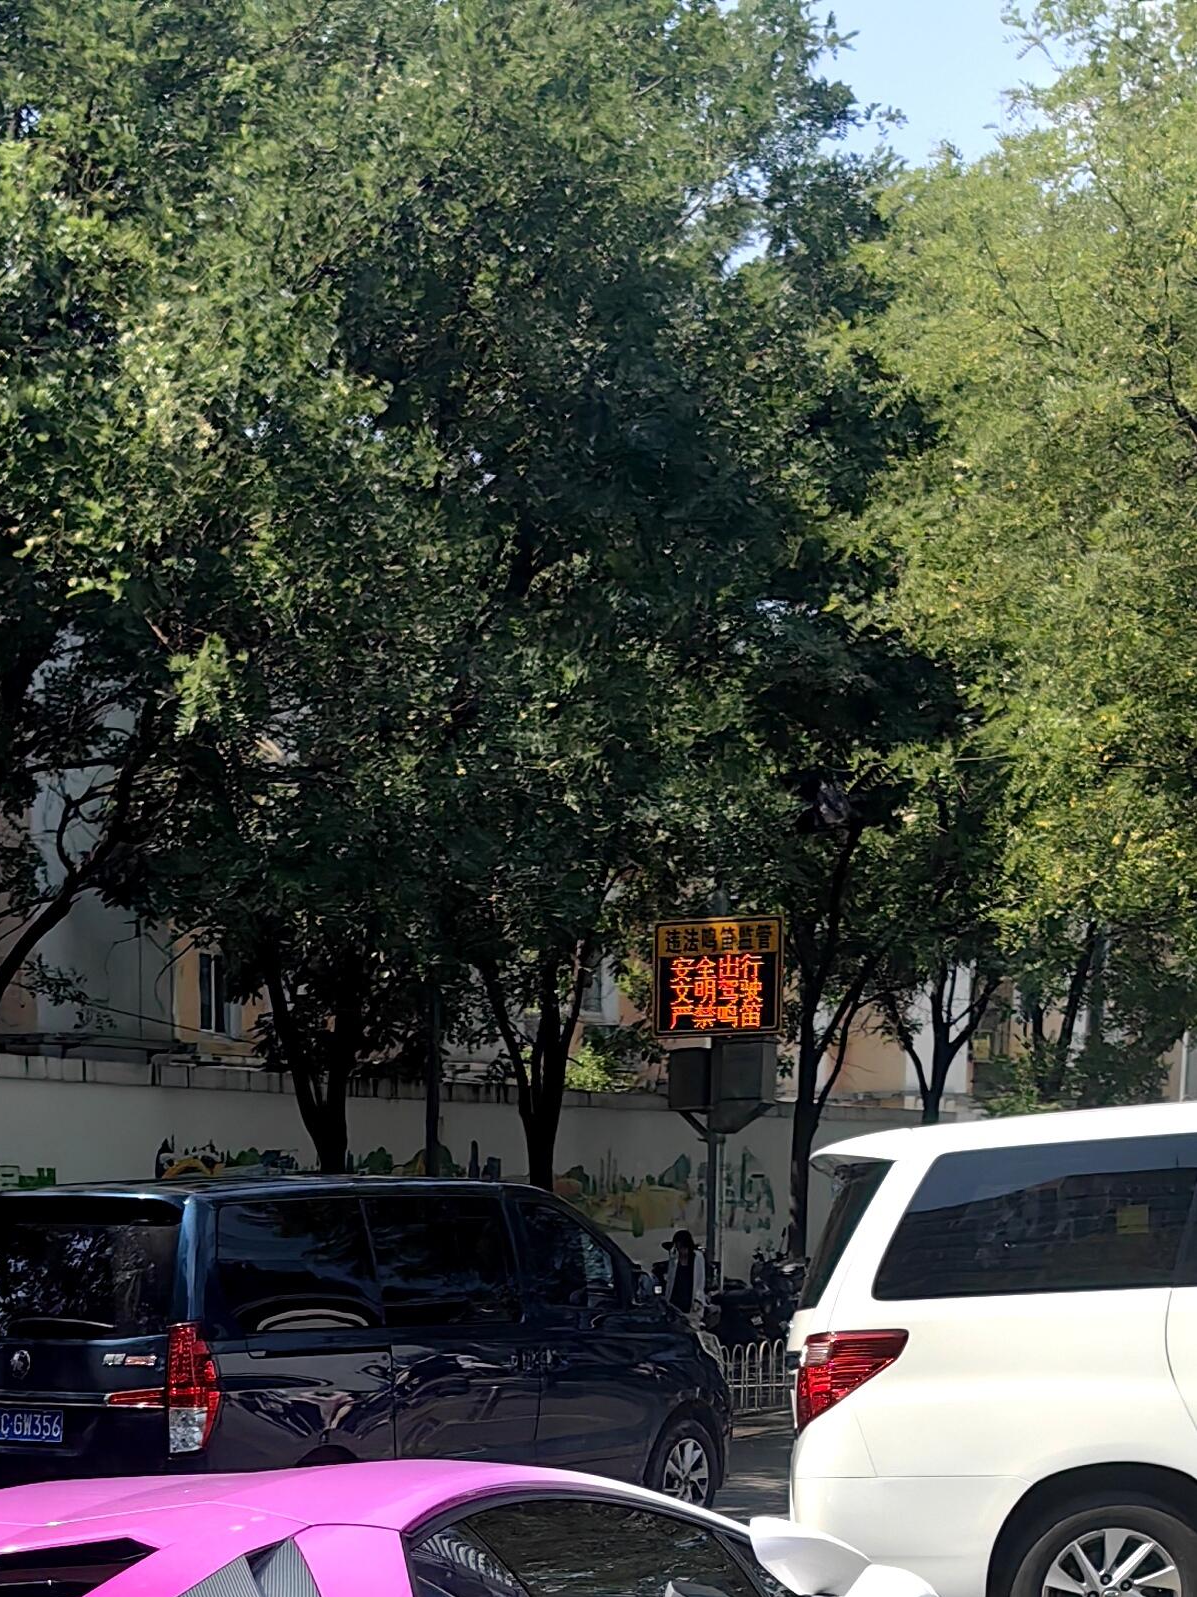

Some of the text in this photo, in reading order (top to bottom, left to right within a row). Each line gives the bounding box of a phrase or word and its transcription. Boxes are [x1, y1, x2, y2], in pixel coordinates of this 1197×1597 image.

[665, 925, 772, 953] 违法鸣笛监管
[670, 954, 765, 982] 安全出行
[670, 980, 764, 1004] 文明驾驶
[670, 1002, 764, 1030] 严禁鸣笛
